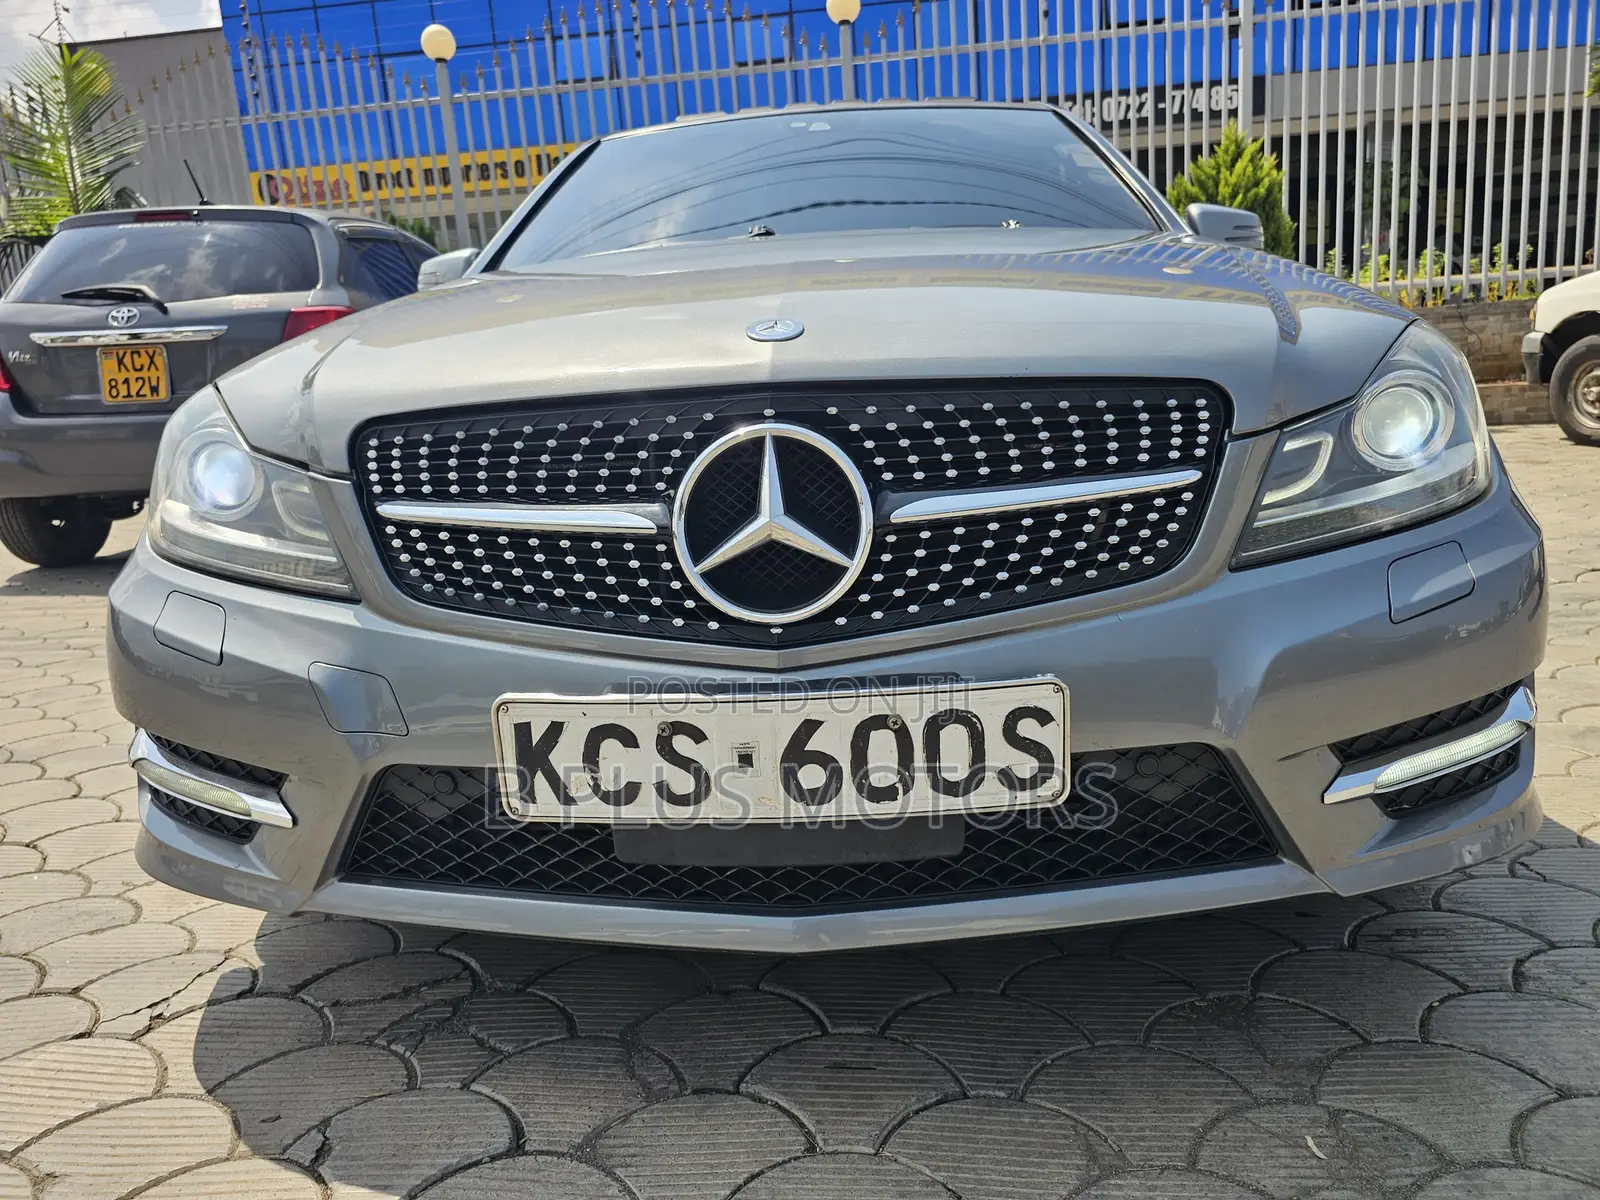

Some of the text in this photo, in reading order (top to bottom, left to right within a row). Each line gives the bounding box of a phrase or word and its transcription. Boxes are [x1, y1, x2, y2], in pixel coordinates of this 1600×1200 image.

[1101, 93, 1150, 122] 0722
[358, 167, 414, 192] Drct
[421, 160, 509, 188] mprers
[514, 154, 532, 178] o
[116, 350, 160, 373] KCX
[108, 376, 160, 399] 812W
[513, 704, 1058, 807] KCS 600S
